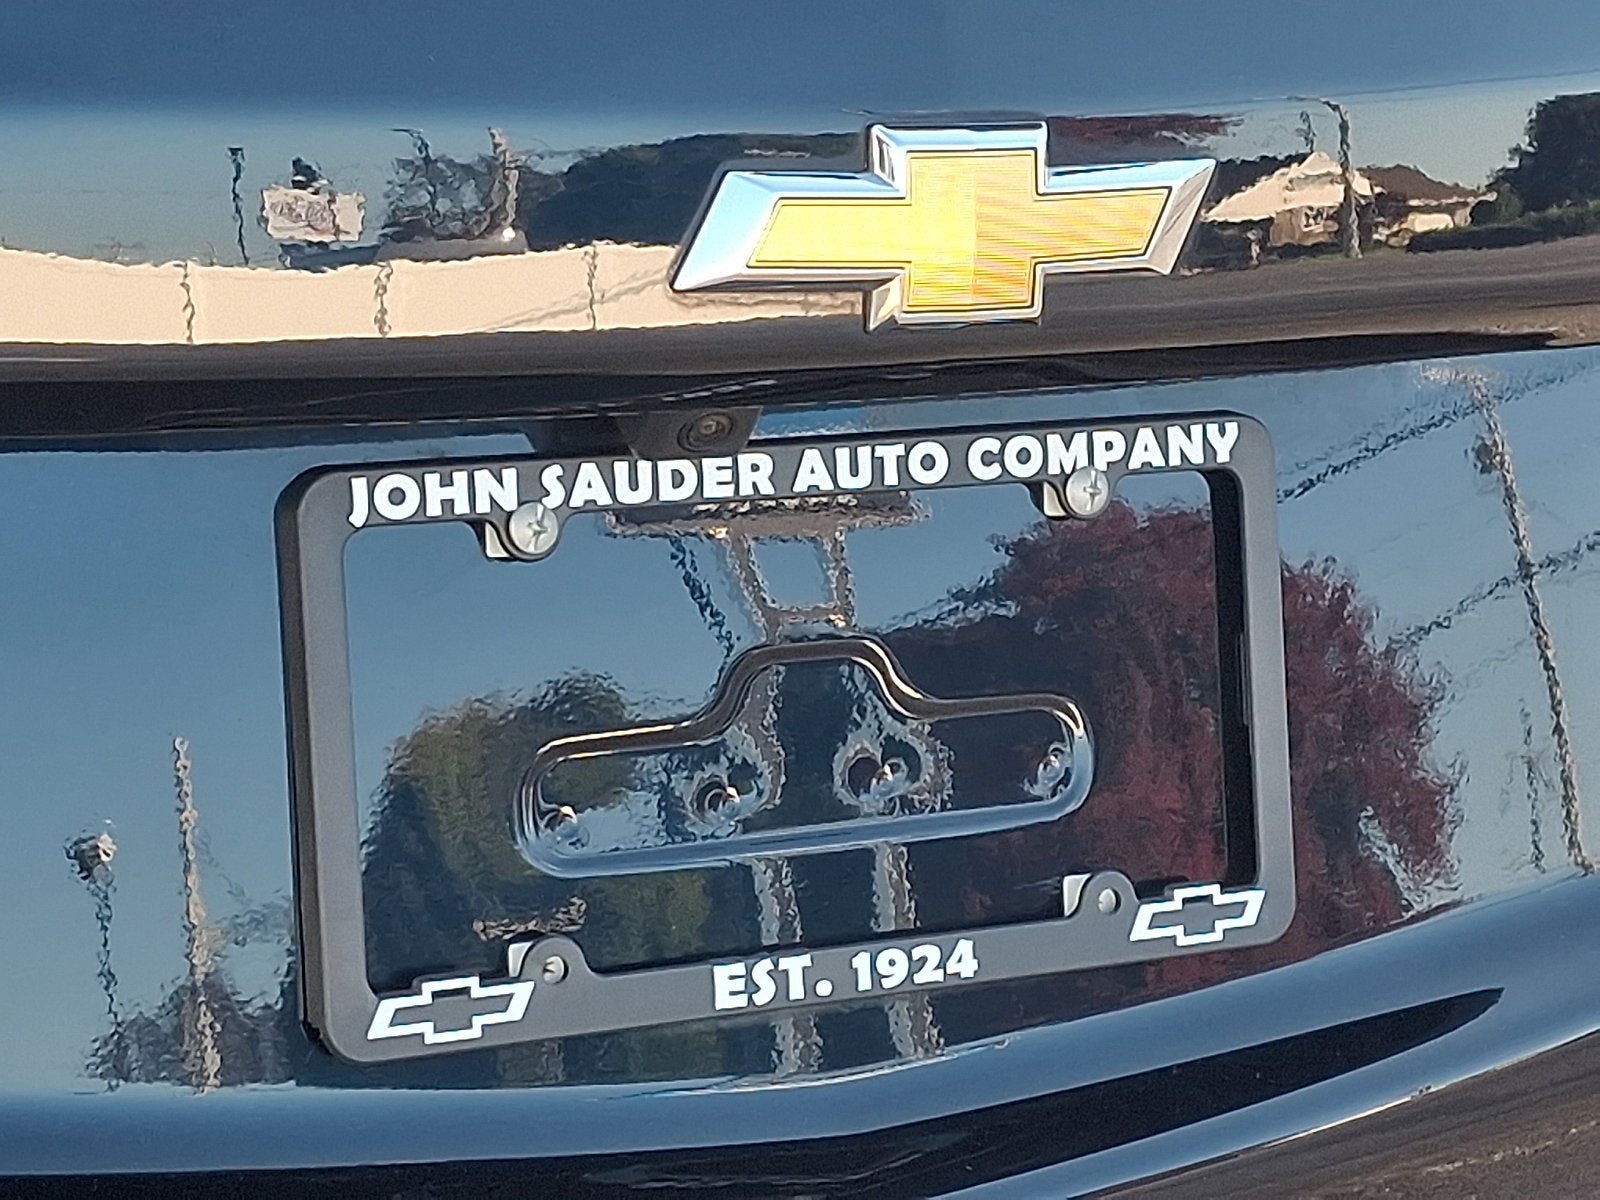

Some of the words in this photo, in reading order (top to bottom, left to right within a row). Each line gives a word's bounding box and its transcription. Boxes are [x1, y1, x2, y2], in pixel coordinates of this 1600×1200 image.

[348, 467, 518, 528] JOHN
[541, 453, 775, 509] SAUDER
[792, 441, 949, 493] AUTO
[967, 421, 1239, 481] COMPANY
[712, 953, 834, 1010] EST.
[851, 938, 979, 992] 1924
